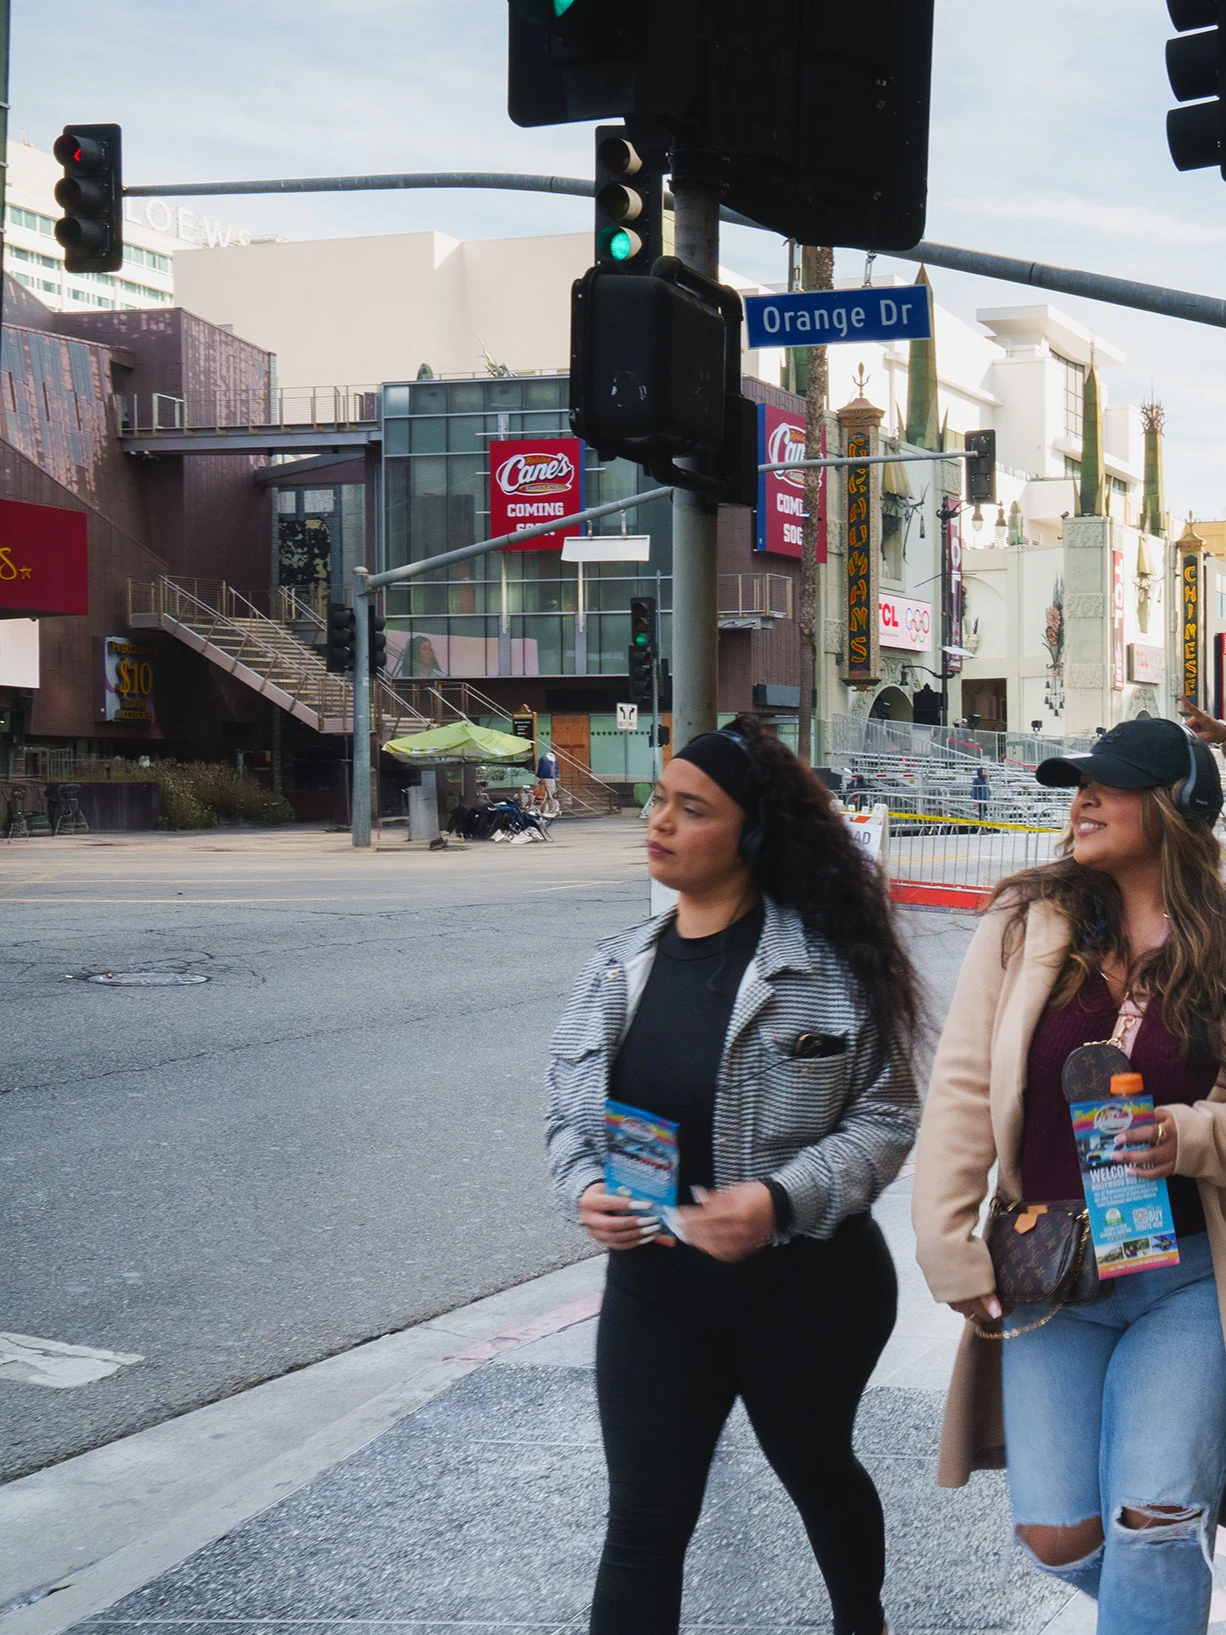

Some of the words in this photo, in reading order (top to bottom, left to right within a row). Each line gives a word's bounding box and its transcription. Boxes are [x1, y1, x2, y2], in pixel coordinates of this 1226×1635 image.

[762, 305, 866, 337] Orange
[880, 299, 913, 327] Dr
[501, 453, 571, 492] Cane's
[507, 502, 564, 517] COMING
[776, 493, 803, 517] COM
[1184, 565, 1197, 696] CHINESE
[120, 657, 153, 697] $10
[853, 831, 871, 845] AD
[1090, 1162, 1136, 1184] WELCOM
[1148, 1208, 1163, 1222] BUY
